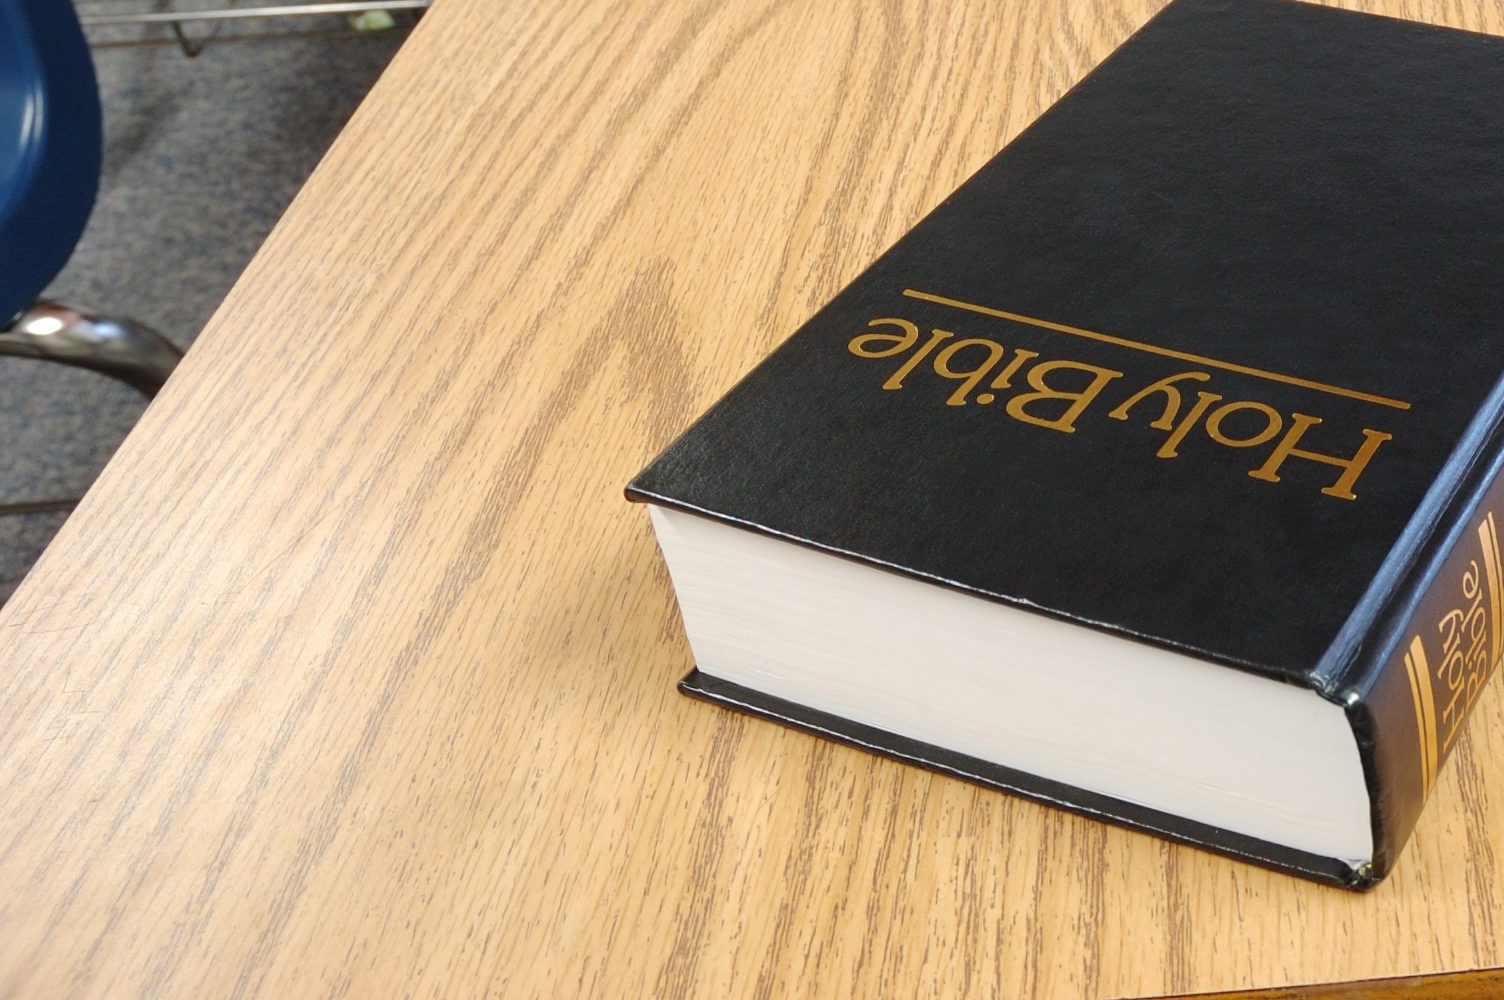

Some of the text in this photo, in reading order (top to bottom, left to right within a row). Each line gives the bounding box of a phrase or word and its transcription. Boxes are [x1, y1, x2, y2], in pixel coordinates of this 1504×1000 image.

[847, 316, 1393, 501] Holy Bible
[1438, 608, 1466, 754] Holy
[1461, 560, 1488, 711] Bible
